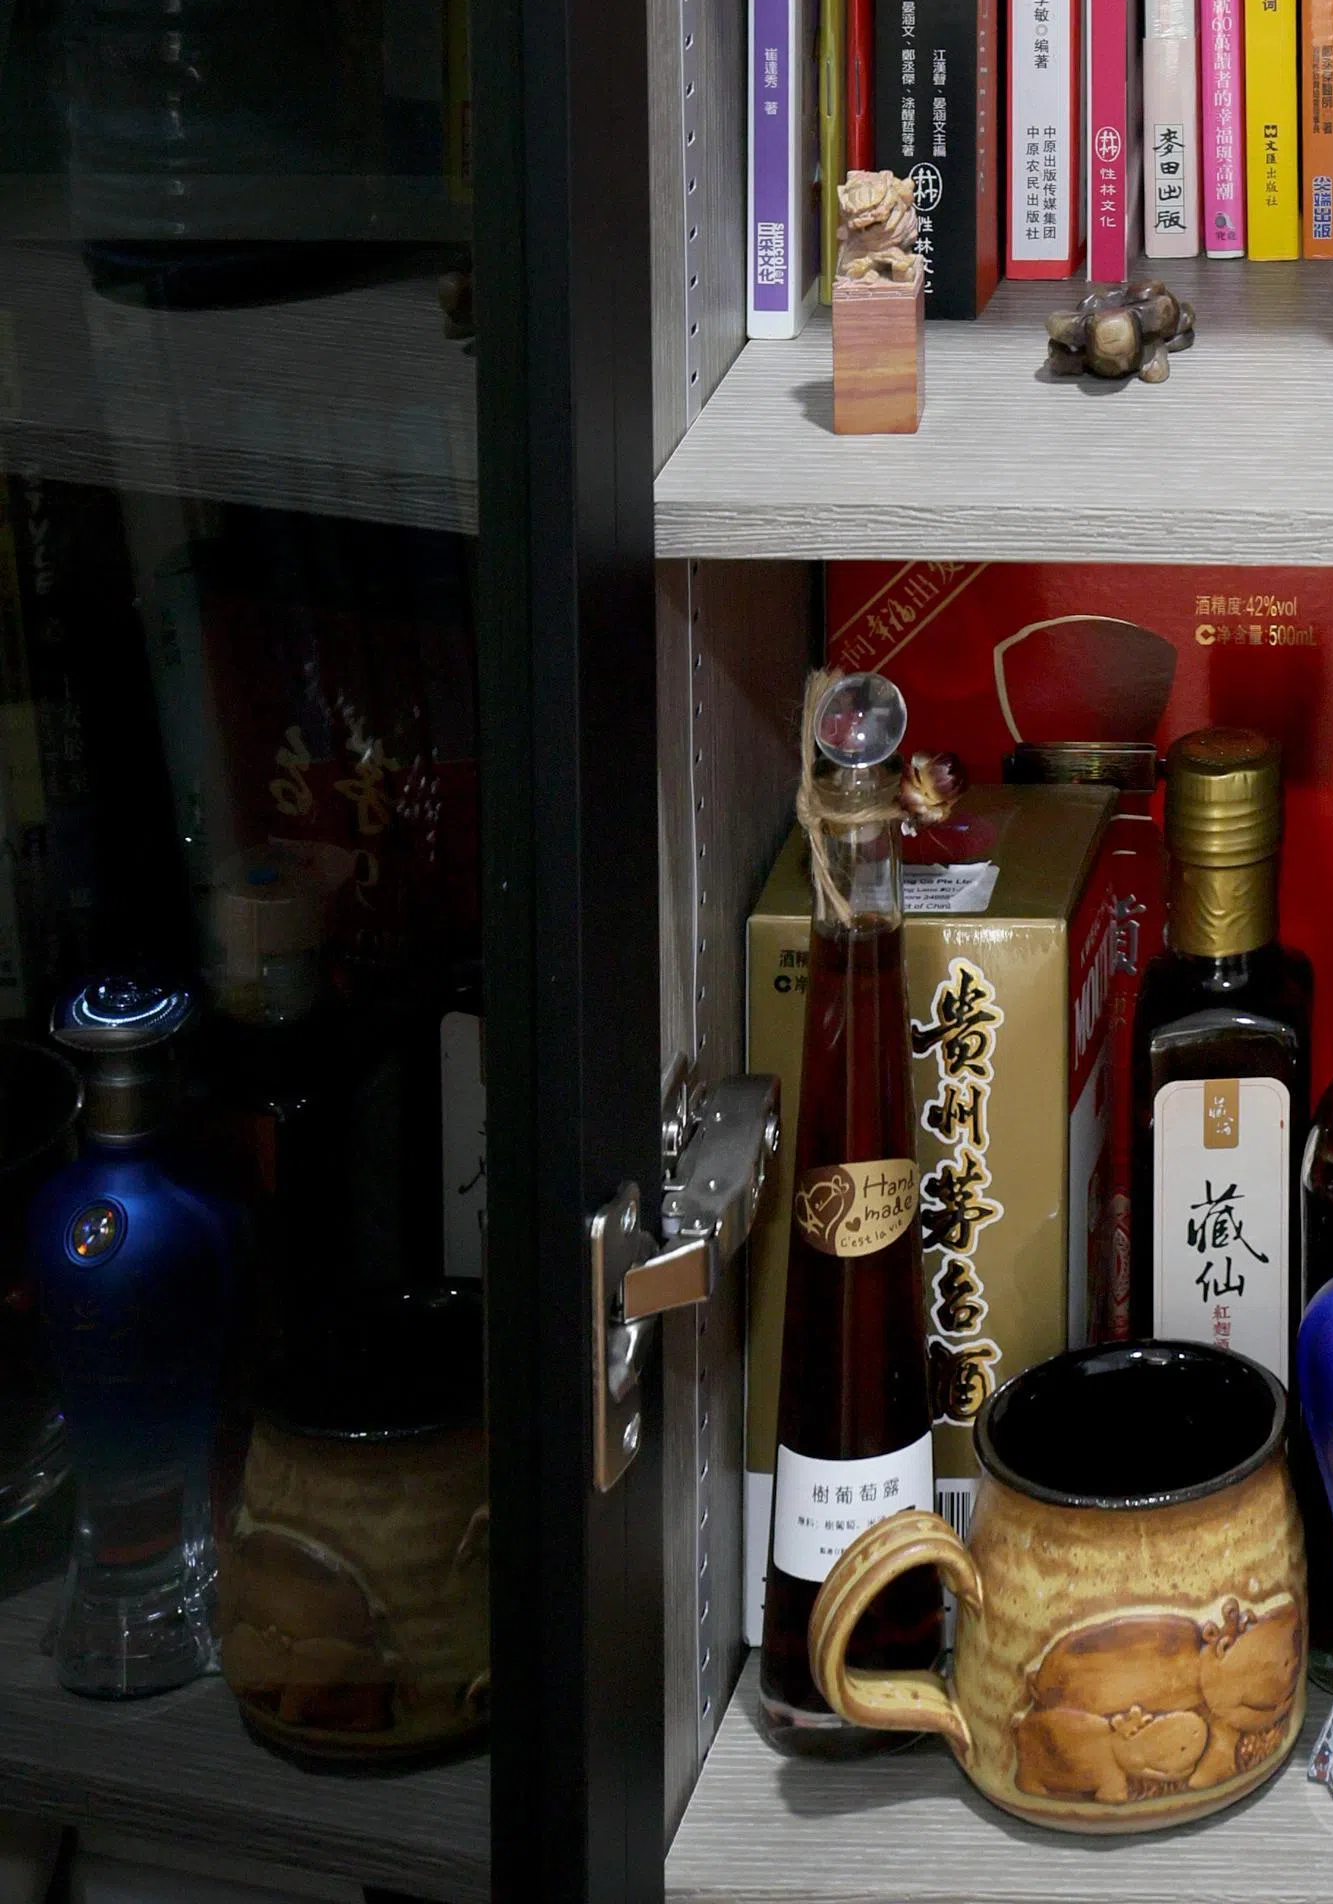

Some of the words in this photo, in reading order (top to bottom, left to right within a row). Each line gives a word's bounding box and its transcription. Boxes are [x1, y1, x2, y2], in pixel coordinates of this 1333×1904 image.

[1025, 126, 1040, 241] 中原农民出版社
[1042, 126, 1057, 241] 中原出版传媒集团
[1098, 167, 1118, 229] 性林文化
[1153, 127, 1188, 230] 麥田出版
[862, 1168, 914, 1198] Hand
[863, 1195, 913, 1221] made
[840, 1233, 872, 1249] C'est
[875, 1229, 887, 1243] la
[812, 1476, 900, 1505] 樹葡萄露
